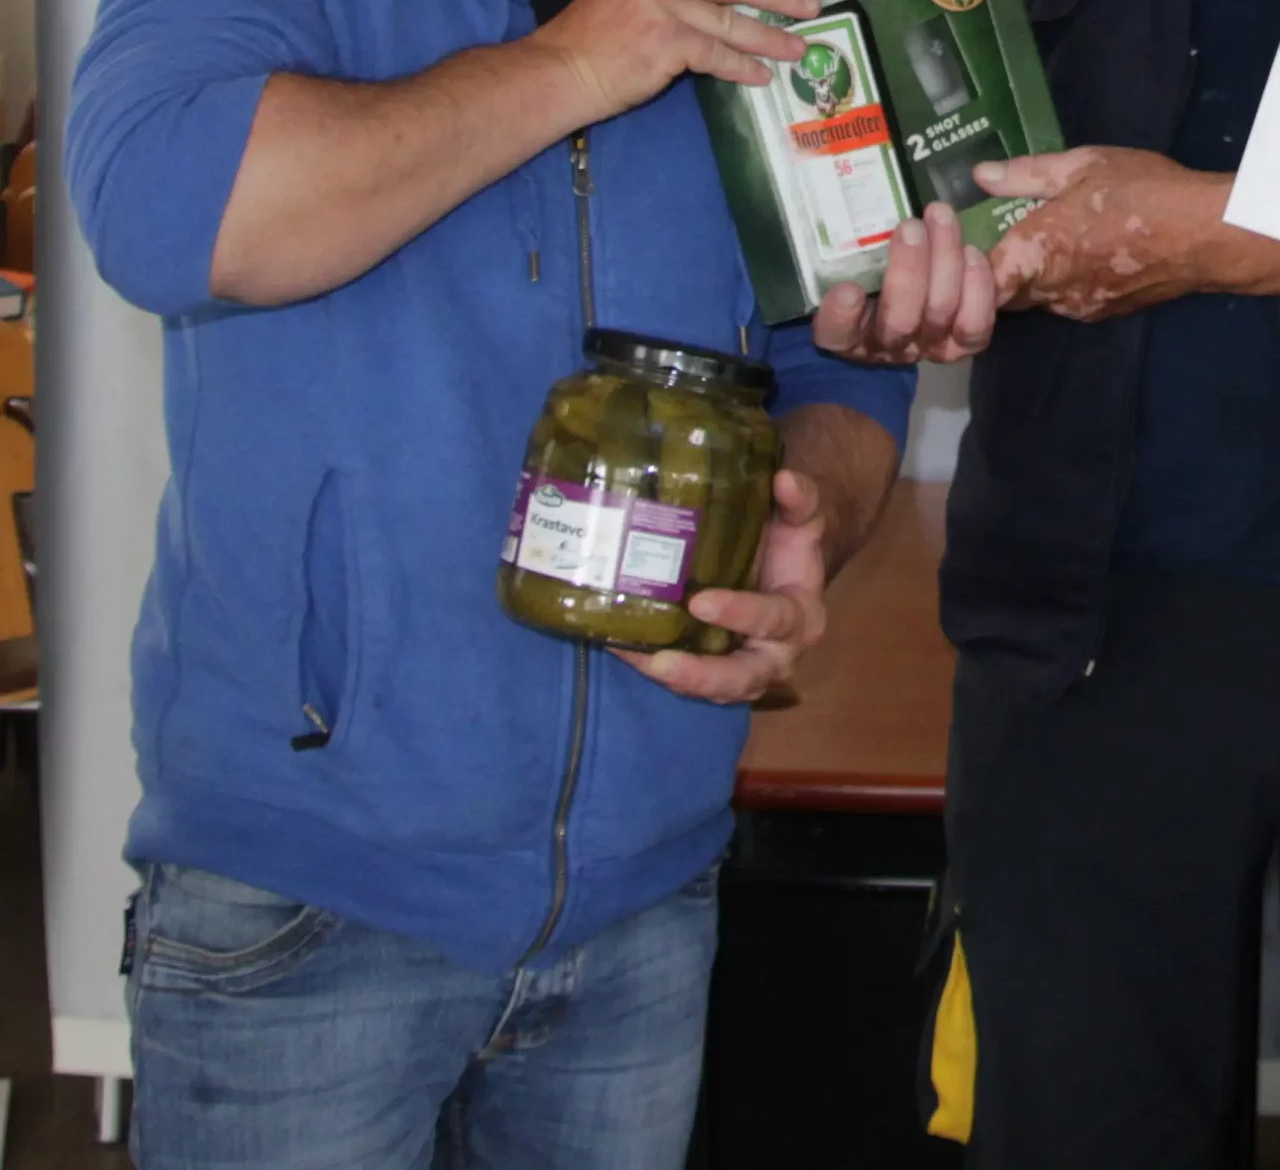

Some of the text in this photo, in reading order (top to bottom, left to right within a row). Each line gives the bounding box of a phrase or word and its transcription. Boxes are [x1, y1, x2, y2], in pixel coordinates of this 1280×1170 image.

[906, 116, 990, 162] 2 GLASSES
[925, 113, 961, 139] SHOT
